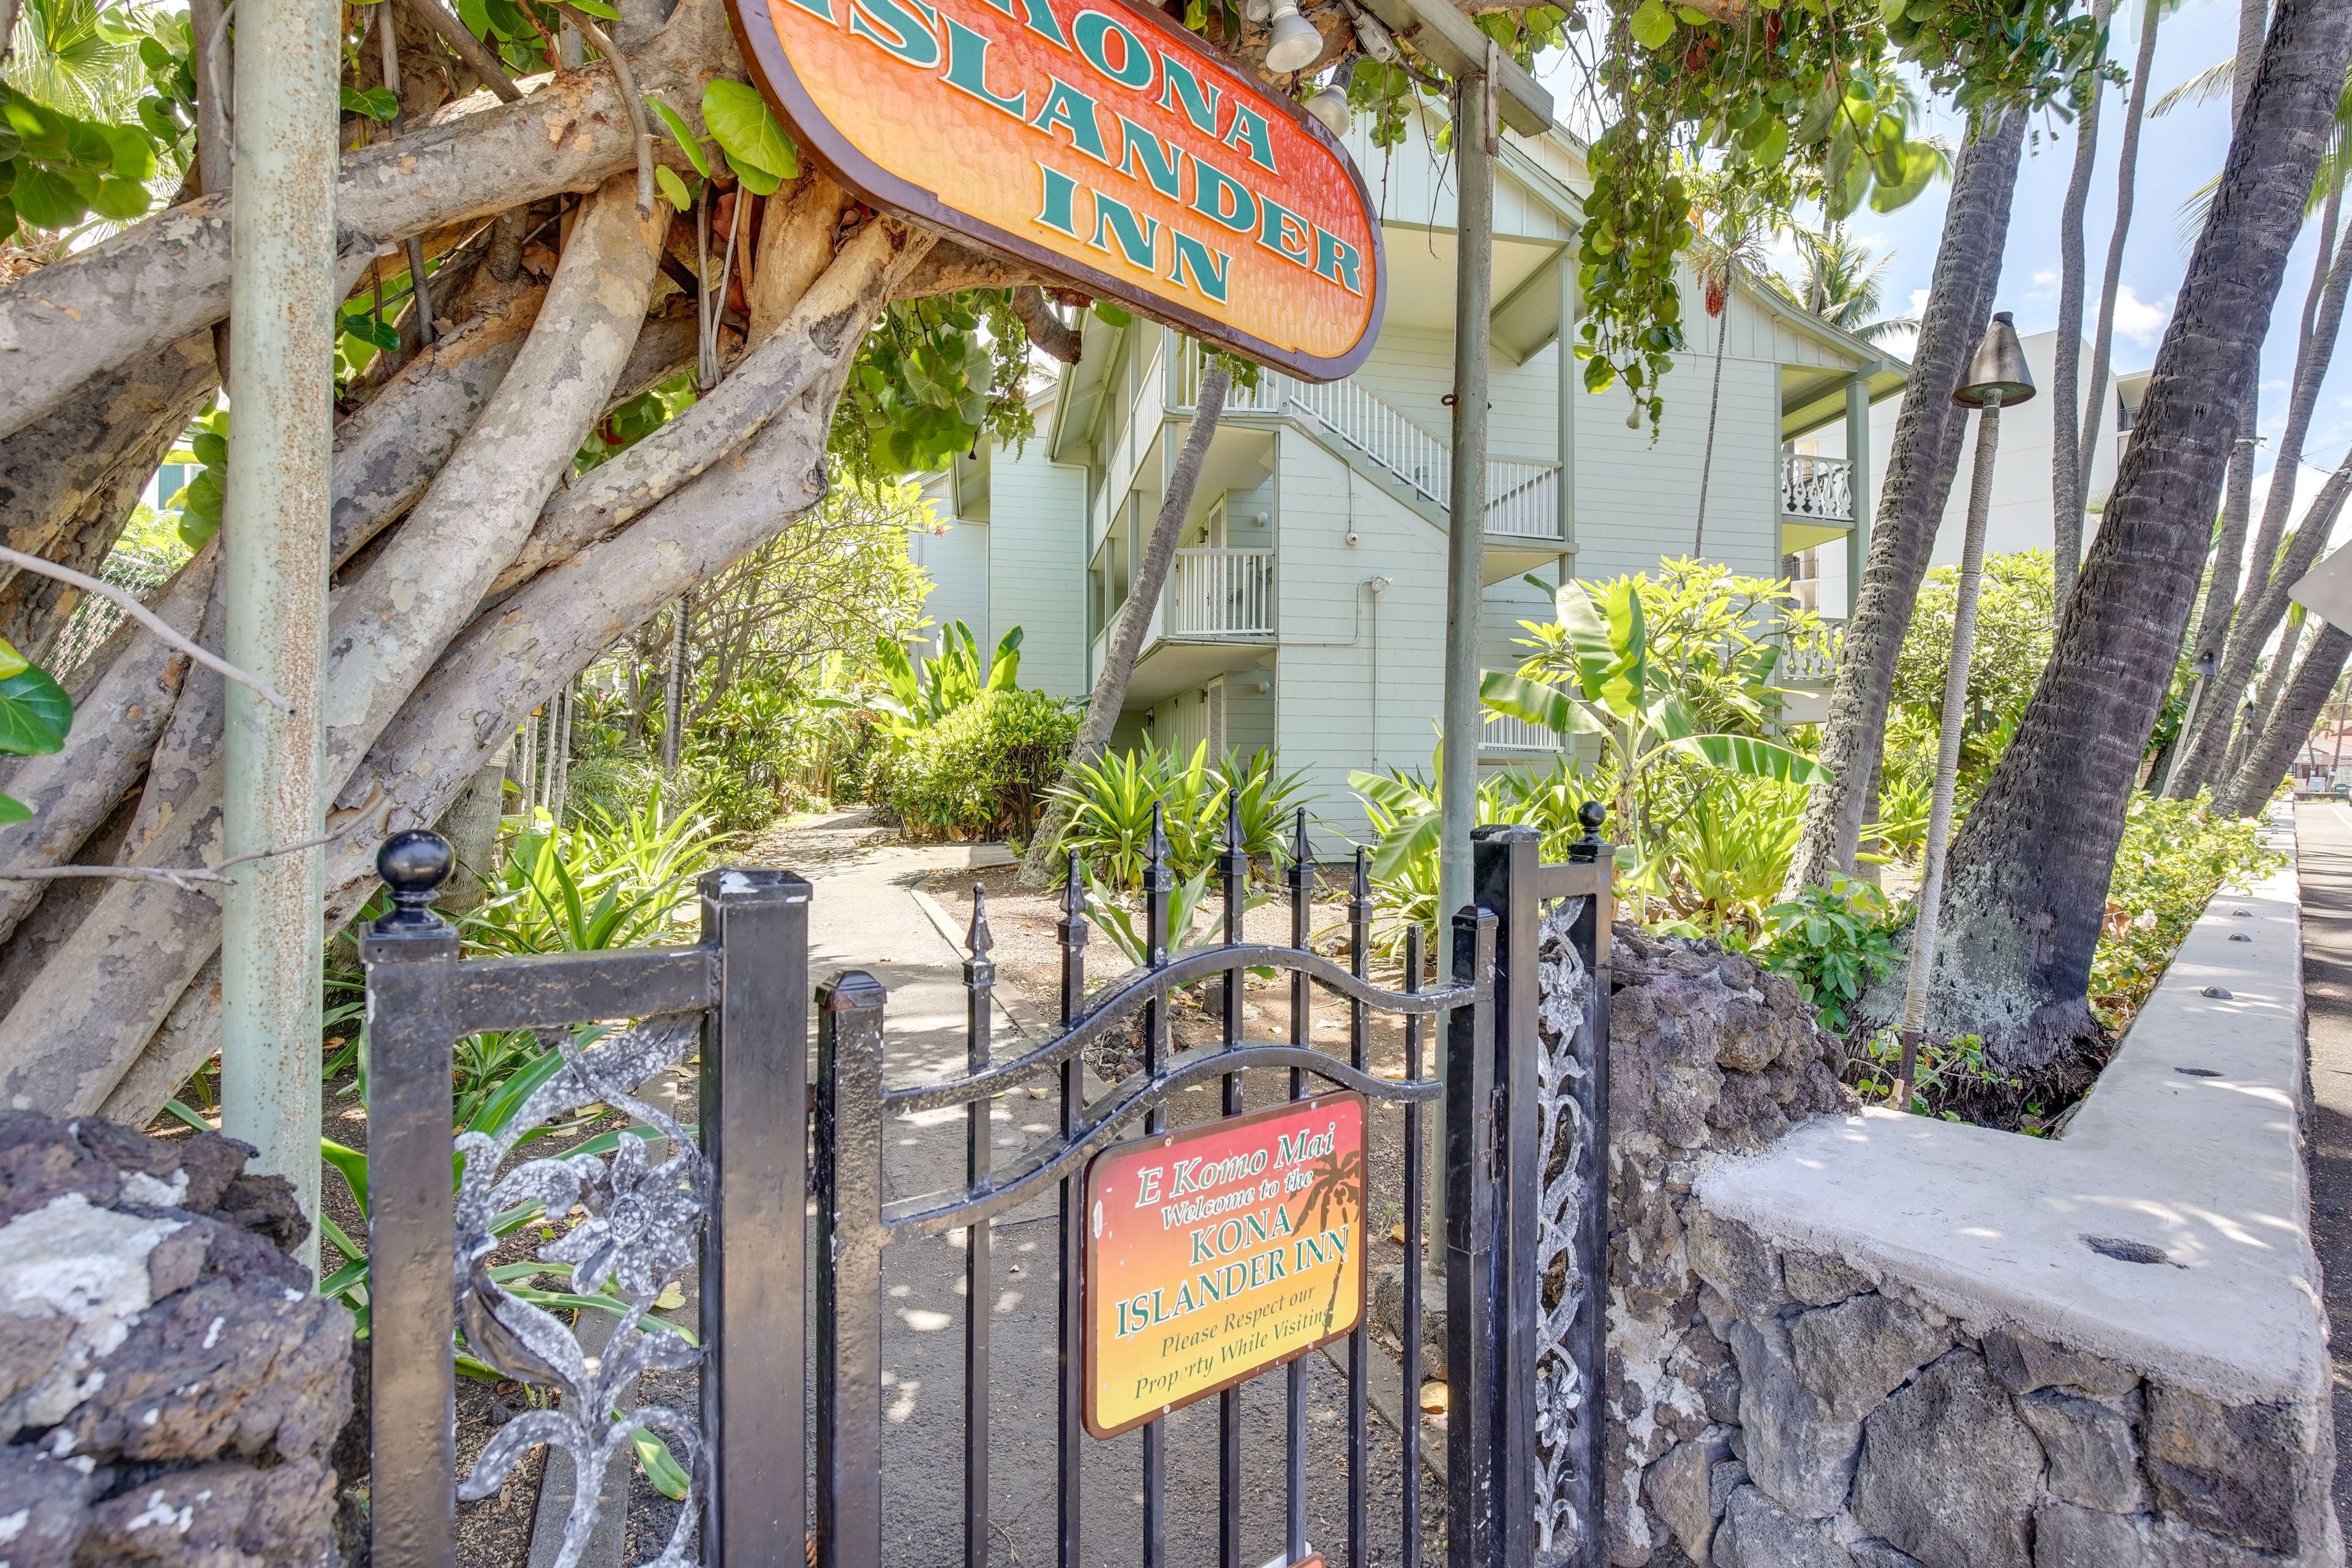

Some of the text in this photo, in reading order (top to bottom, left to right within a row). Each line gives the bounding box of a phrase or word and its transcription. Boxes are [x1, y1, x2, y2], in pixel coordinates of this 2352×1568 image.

[1032, 161, 1234, 305] INN
[1135, 1122, 1336, 1208] E Komo Mai
[1161, 1168, 1313, 1230] Welcome to the
[1189, 1205, 1292, 1266] KONA
[1115, 1224, 1349, 1339] ISLANDER INN
[1160, 1286, 1315, 1358] Please Respect our
[1134, 1308, 1332, 1400] Proprty While Visiting
